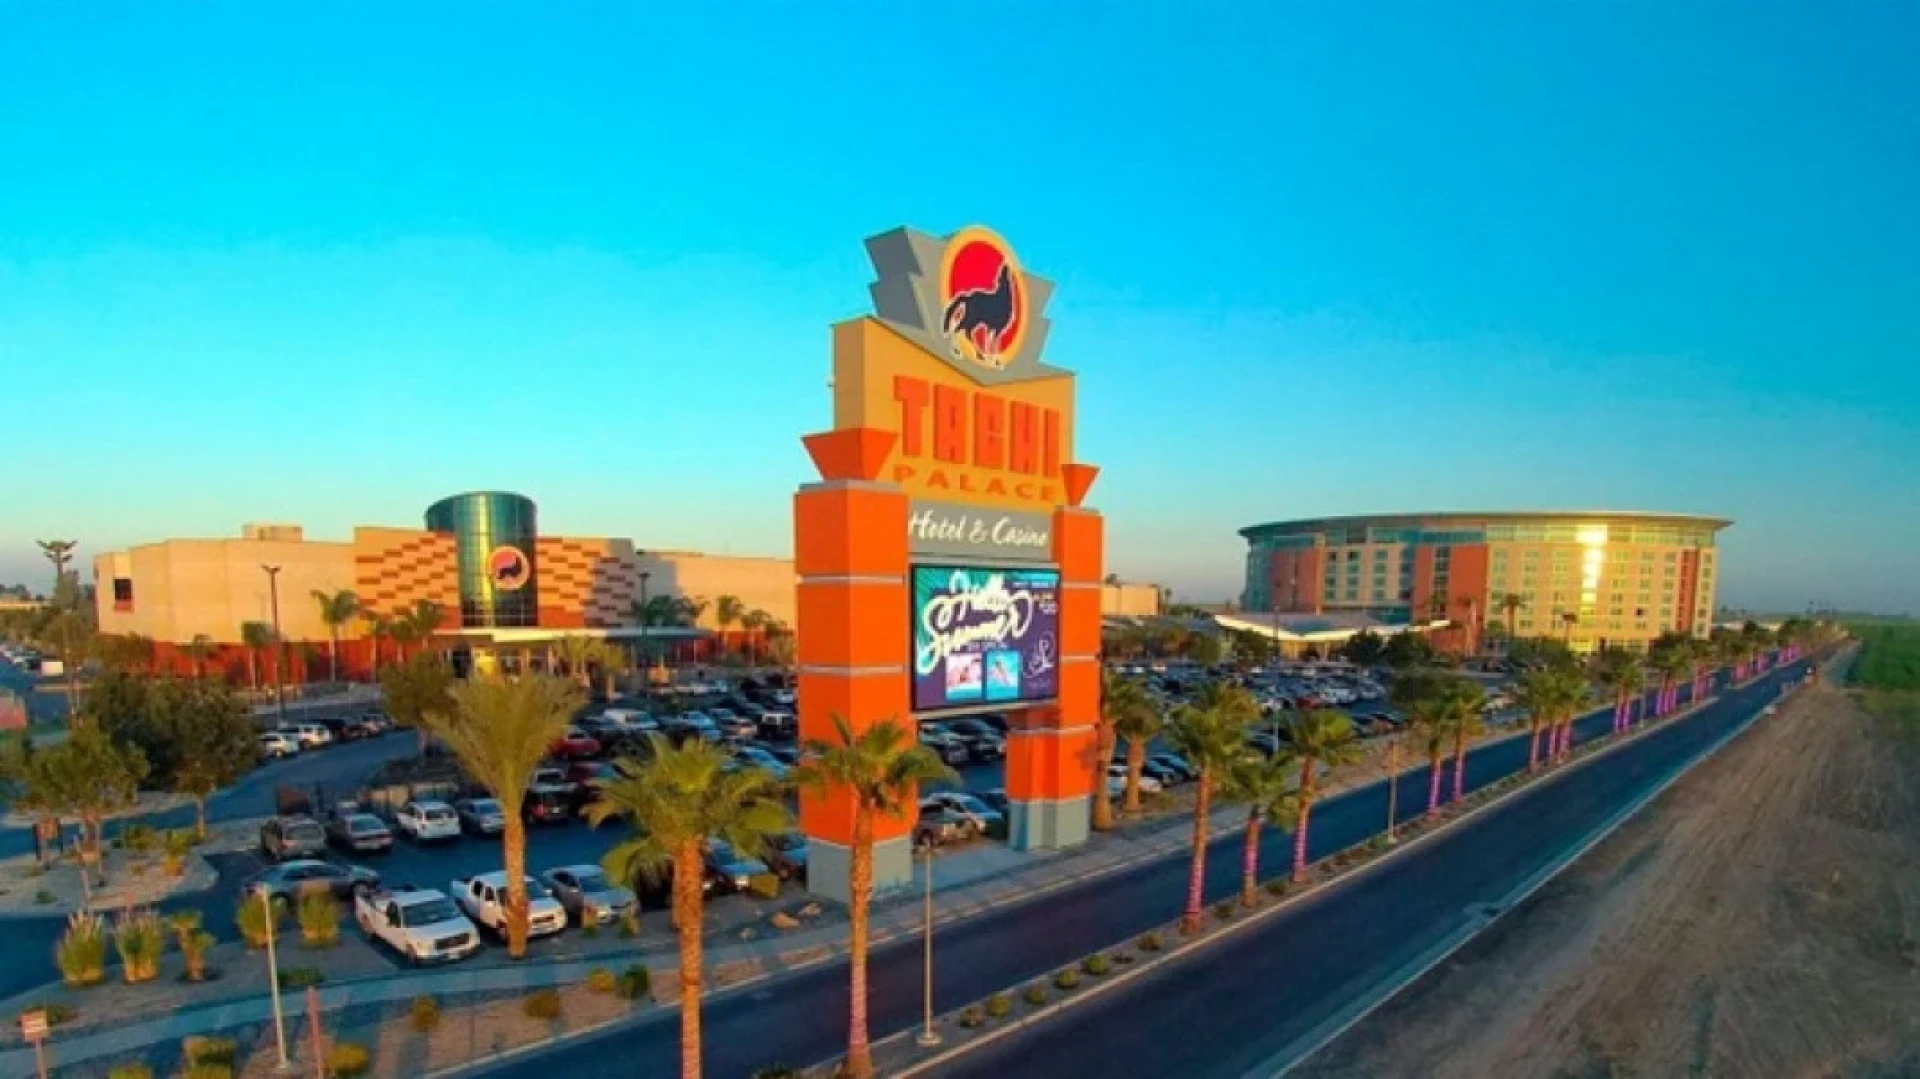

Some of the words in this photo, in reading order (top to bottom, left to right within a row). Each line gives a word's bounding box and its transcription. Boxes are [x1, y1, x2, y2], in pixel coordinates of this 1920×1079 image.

[893, 374, 1060, 478] TACHI
[893, 464, 1056, 501] PALACE
[908, 510, 967, 540] Hotel
[969, 519, 986, 544] &
[991, 517, 1049, 548] Casino
